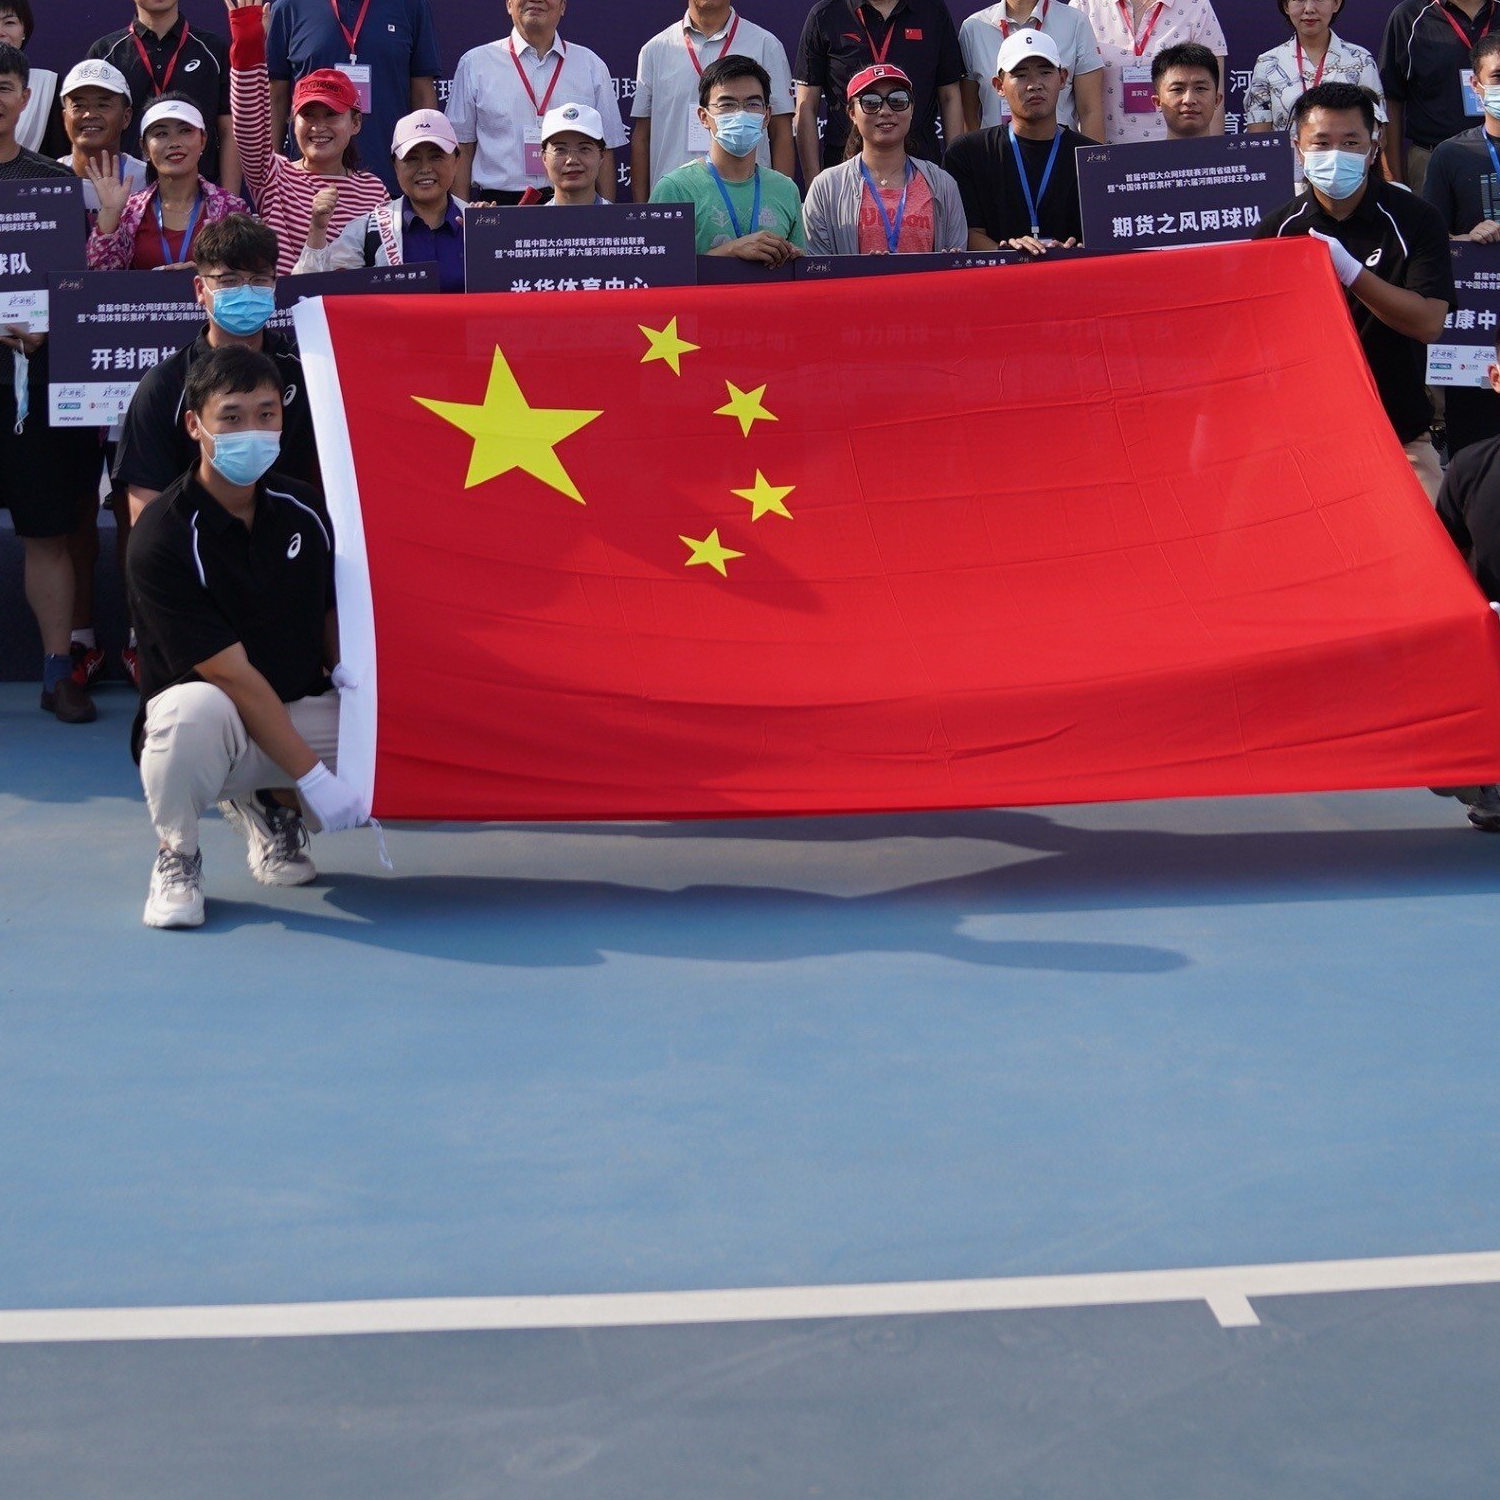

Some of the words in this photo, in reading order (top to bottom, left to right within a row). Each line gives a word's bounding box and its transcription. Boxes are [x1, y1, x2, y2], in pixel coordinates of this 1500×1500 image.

[1025, 36, 1033, 45] C
[1125, 165, 1247, 182] 首届中国大众网球联赛河南省级联赛
[1107, 172, 1267, 194] 暨“中国体育彩票杯”第六届河南网球球王争霸赛
[1111, 206, 1261, 238] 期货之风网球队
[515, 236, 645, 248] 首届中国大众网球联赛河南省级联赛
[494, 246, 666, 259] 暨“中国体育彩票杯”第六届河南网球球王争霸赛
[97, 302, 205, 312] 首届中国大众网球联赛河南省
